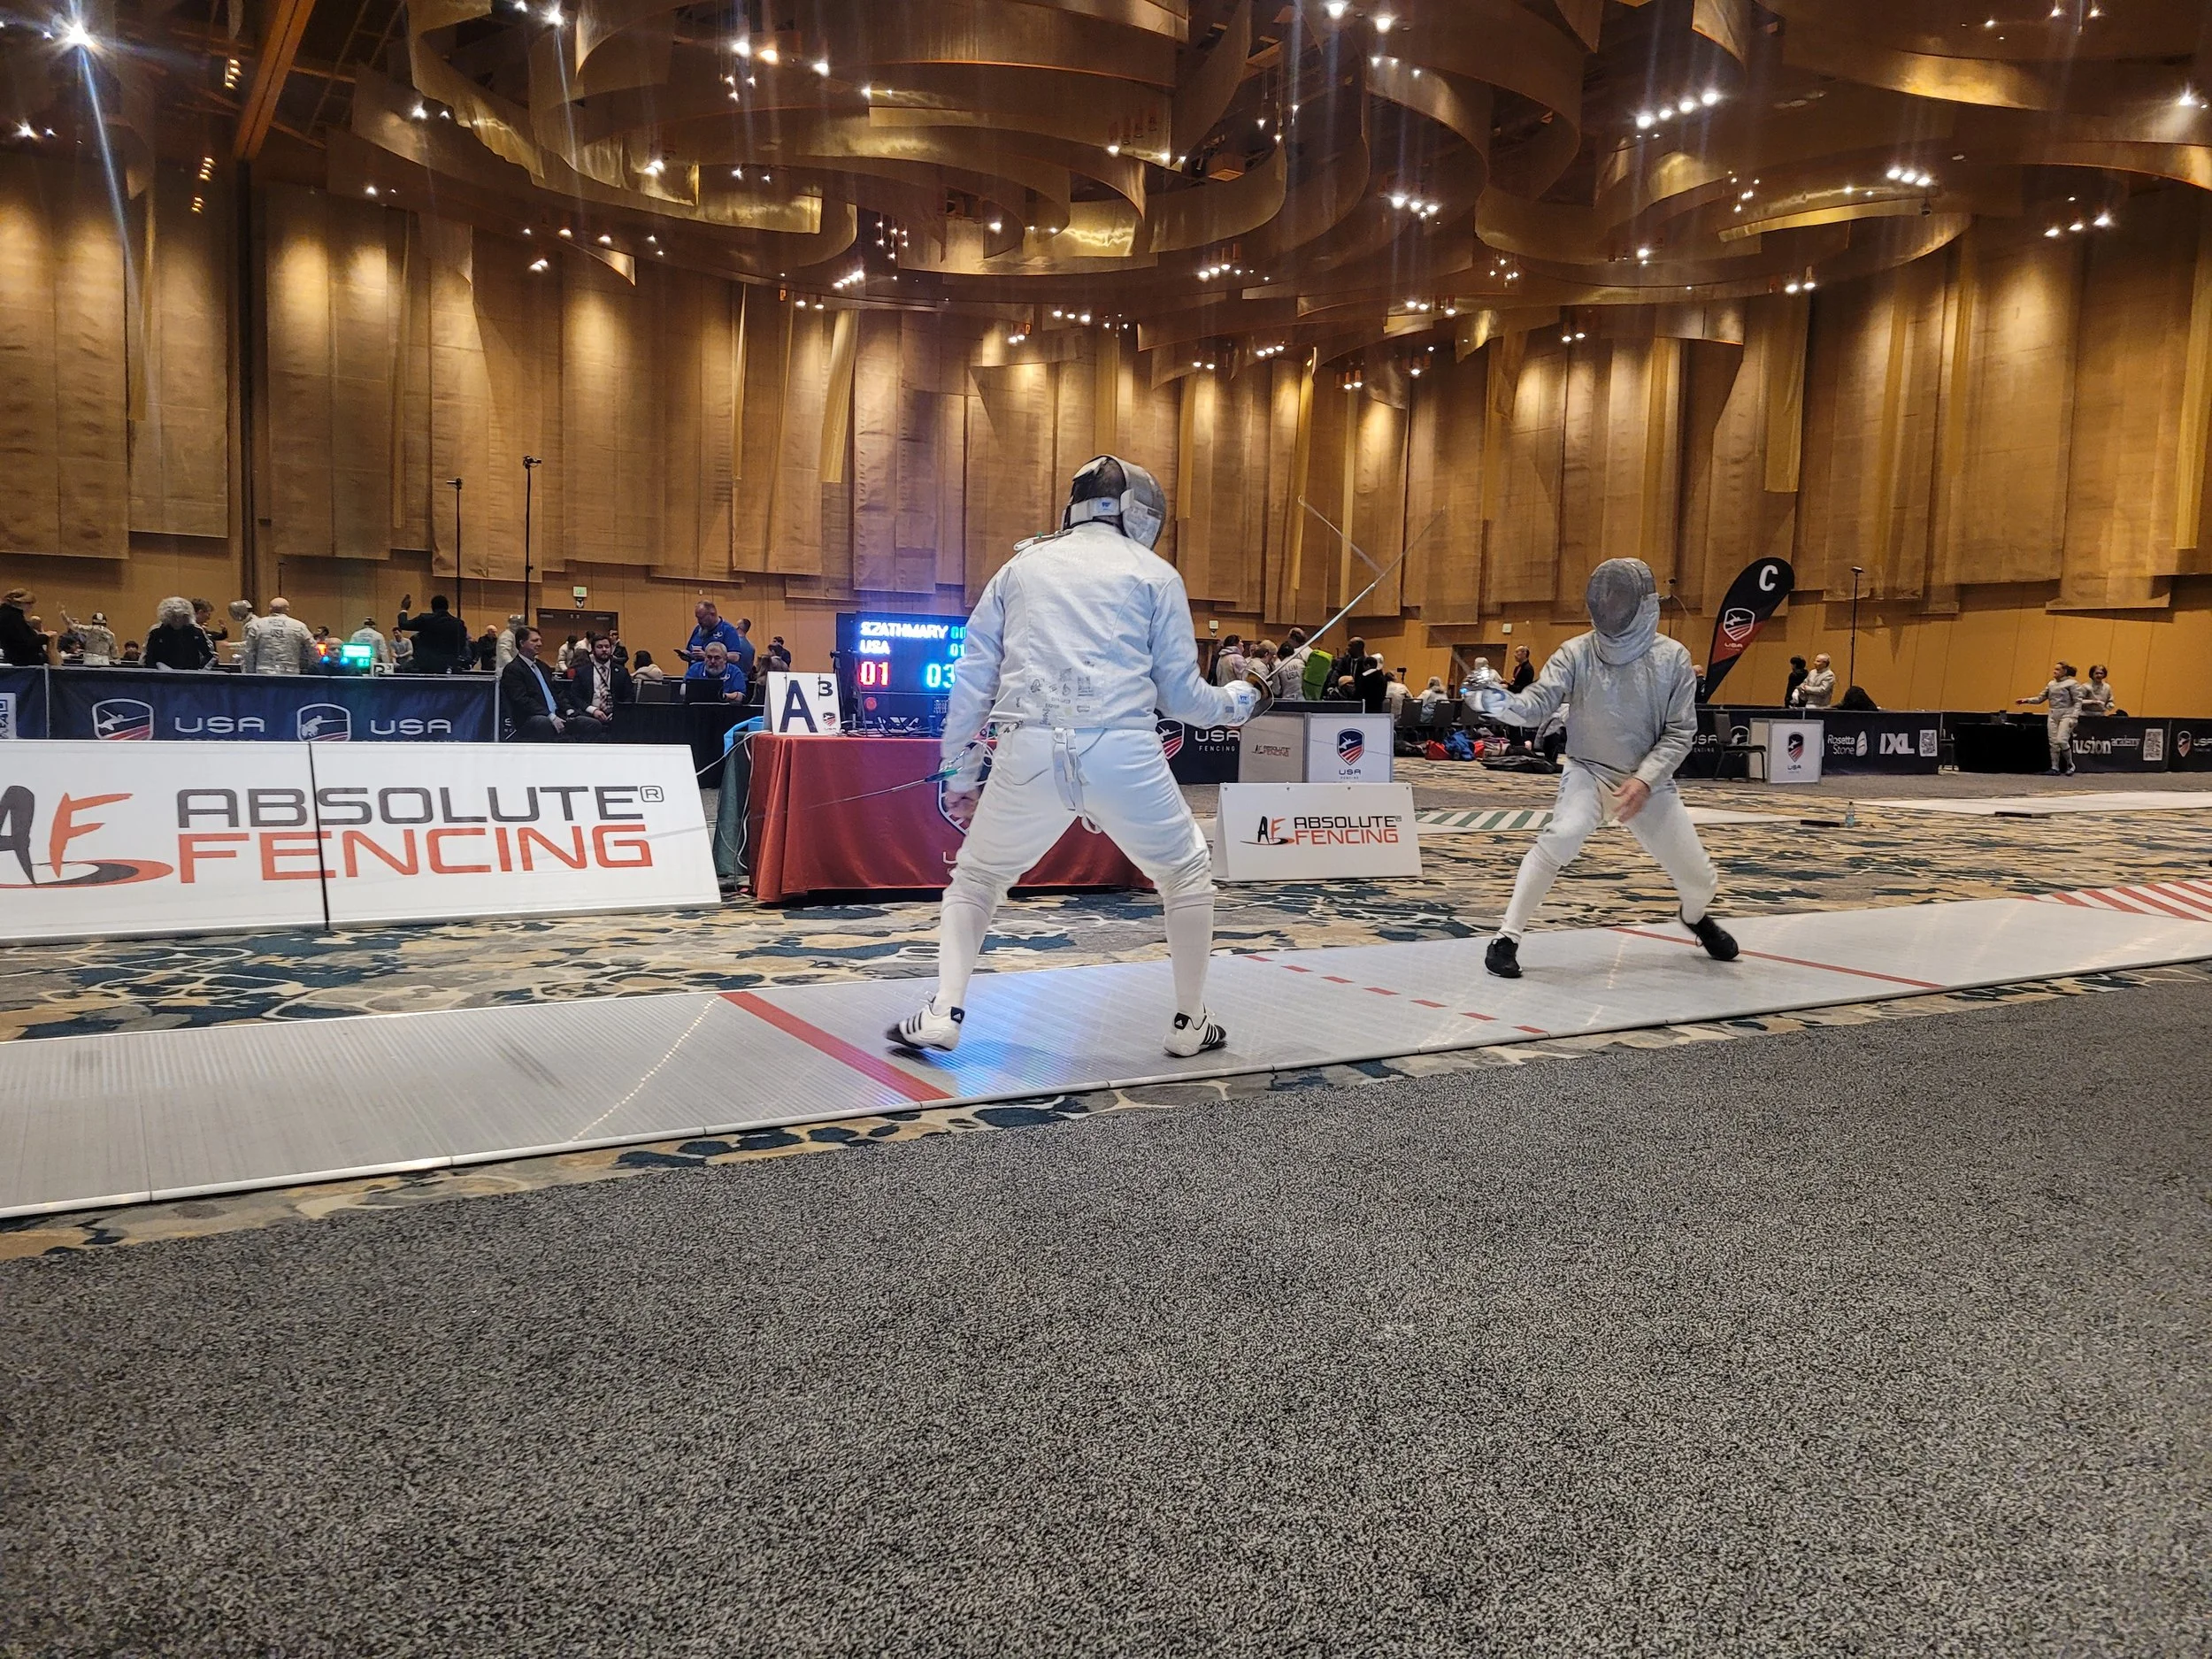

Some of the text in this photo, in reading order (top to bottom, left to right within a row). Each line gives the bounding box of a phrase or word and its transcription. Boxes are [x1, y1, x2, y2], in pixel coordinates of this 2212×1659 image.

[1758, 565, 1778, 592] C
[860, 621, 949, 639] SZATHMARY
[859, 639, 890, 655] USA
[859, 661, 956, 688] 01 03
[818, 680, 833, 697] 3
[779, 680, 818, 733] A
[174, 716, 265, 733] USA
[370, 718, 452, 735] USA
[1194, 729, 1240, 742] USA
[1827, 734, 1855, 745] Rosetta
[1879, 733, 1915, 755] IXL
[1832, 745, 1855, 755] Stone
[1294, 828, 1400, 845] FENCING
[178, 824, 654, 884] FENCING
